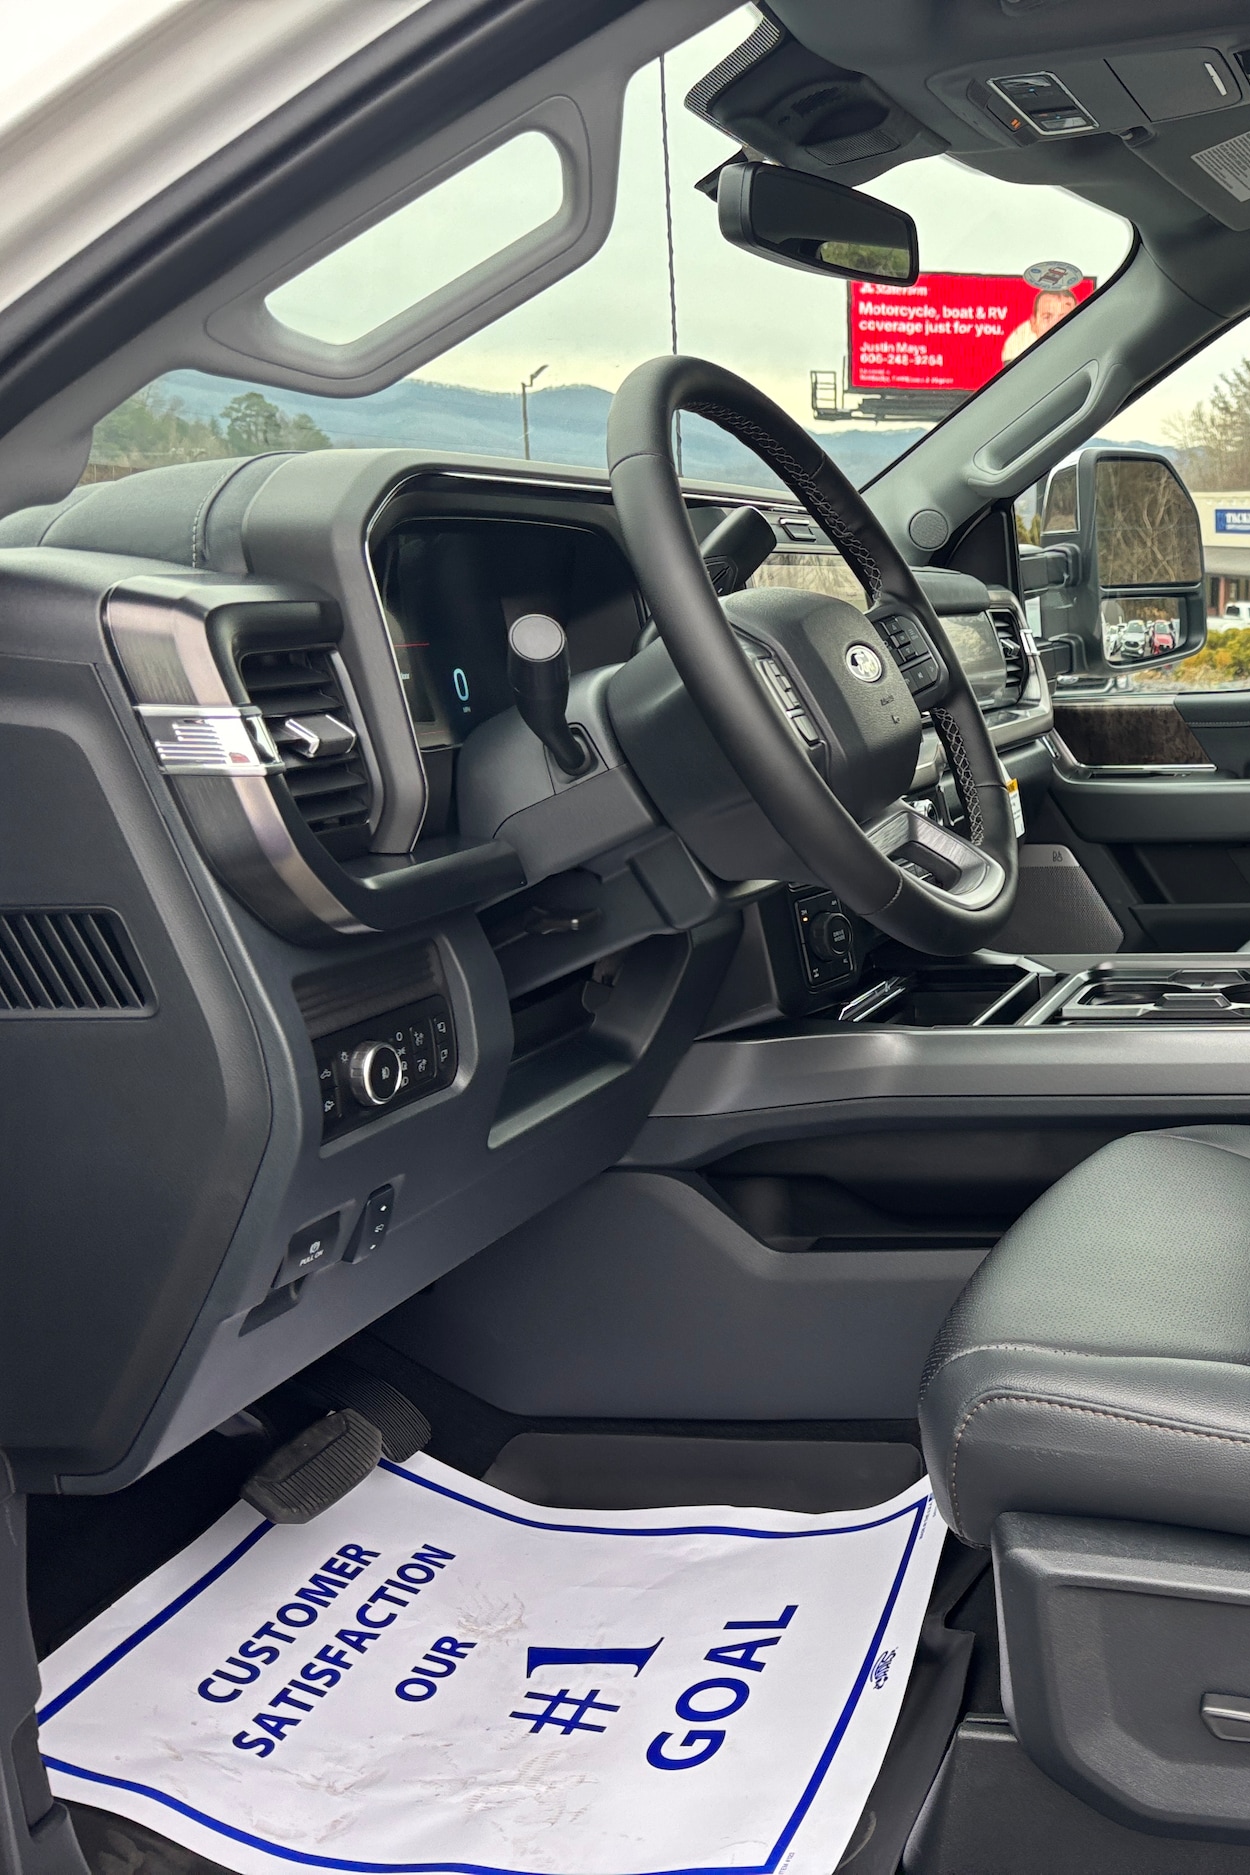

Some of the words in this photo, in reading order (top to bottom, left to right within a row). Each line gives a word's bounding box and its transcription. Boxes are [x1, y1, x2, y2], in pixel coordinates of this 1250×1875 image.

[859, 302, 940, 320] Motorcycle,
[942, 305, 974, 319] boat
[976, 307, 986, 319] &
[988, 306, 1007, 320] RV
[859, 321, 922, 336] coverage
[925, 320, 951, 336] just
[953, 321, 973, 333] for
[975, 323, 1004, 337] you.
[860, 342, 895, 353] Justin
[896, 342, 927, 355] Mays
[197, 1543, 381, 1703] CUSTOMER
[232, 1543, 457, 1758] SATISFACTION
[395, 1635, 478, 1702] OUR
[509, 1637, 665, 1735] #1
[646, 1604, 799, 1771] GOAL
